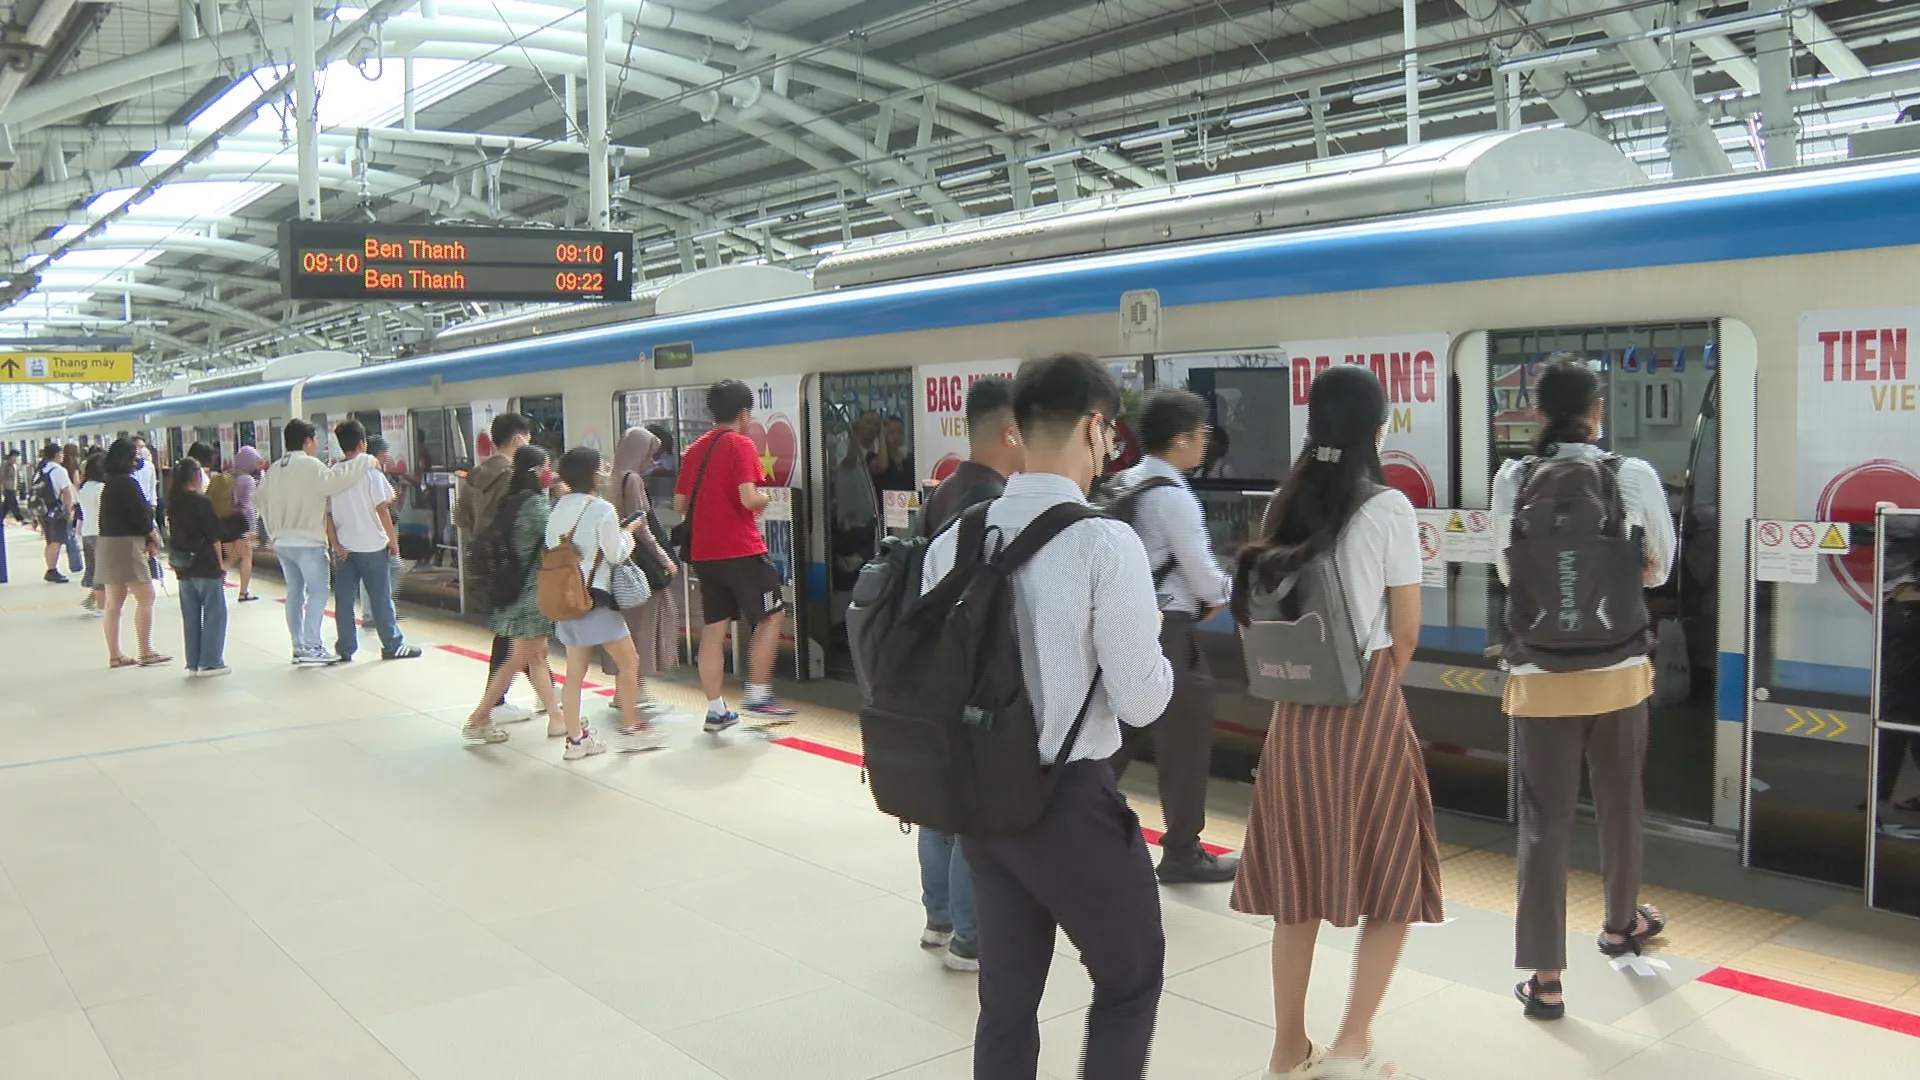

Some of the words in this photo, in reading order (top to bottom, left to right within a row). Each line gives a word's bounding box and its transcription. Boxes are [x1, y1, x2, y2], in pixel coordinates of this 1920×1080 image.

[303, 252, 361, 273] 09:10
[364, 238, 404, 259] Ben
[408, 239, 467, 260] Thanh
[556, 243, 605, 263] 09:10
[364, 268, 404, 289] Ben
[408, 269, 467, 290] Thanh
[555, 272, 604, 291] 09:22
[613, 251, 625, 282] 1
[53, 357, 88, 370] Thang
[1817, 328, 1908, 382] TIEN
[1344, 350, 1436, 403] ANG
[757, 382, 773, 410] TÔI
[926, 375, 962, 412] BAC
[1870, 384, 1920, 411] VIE
